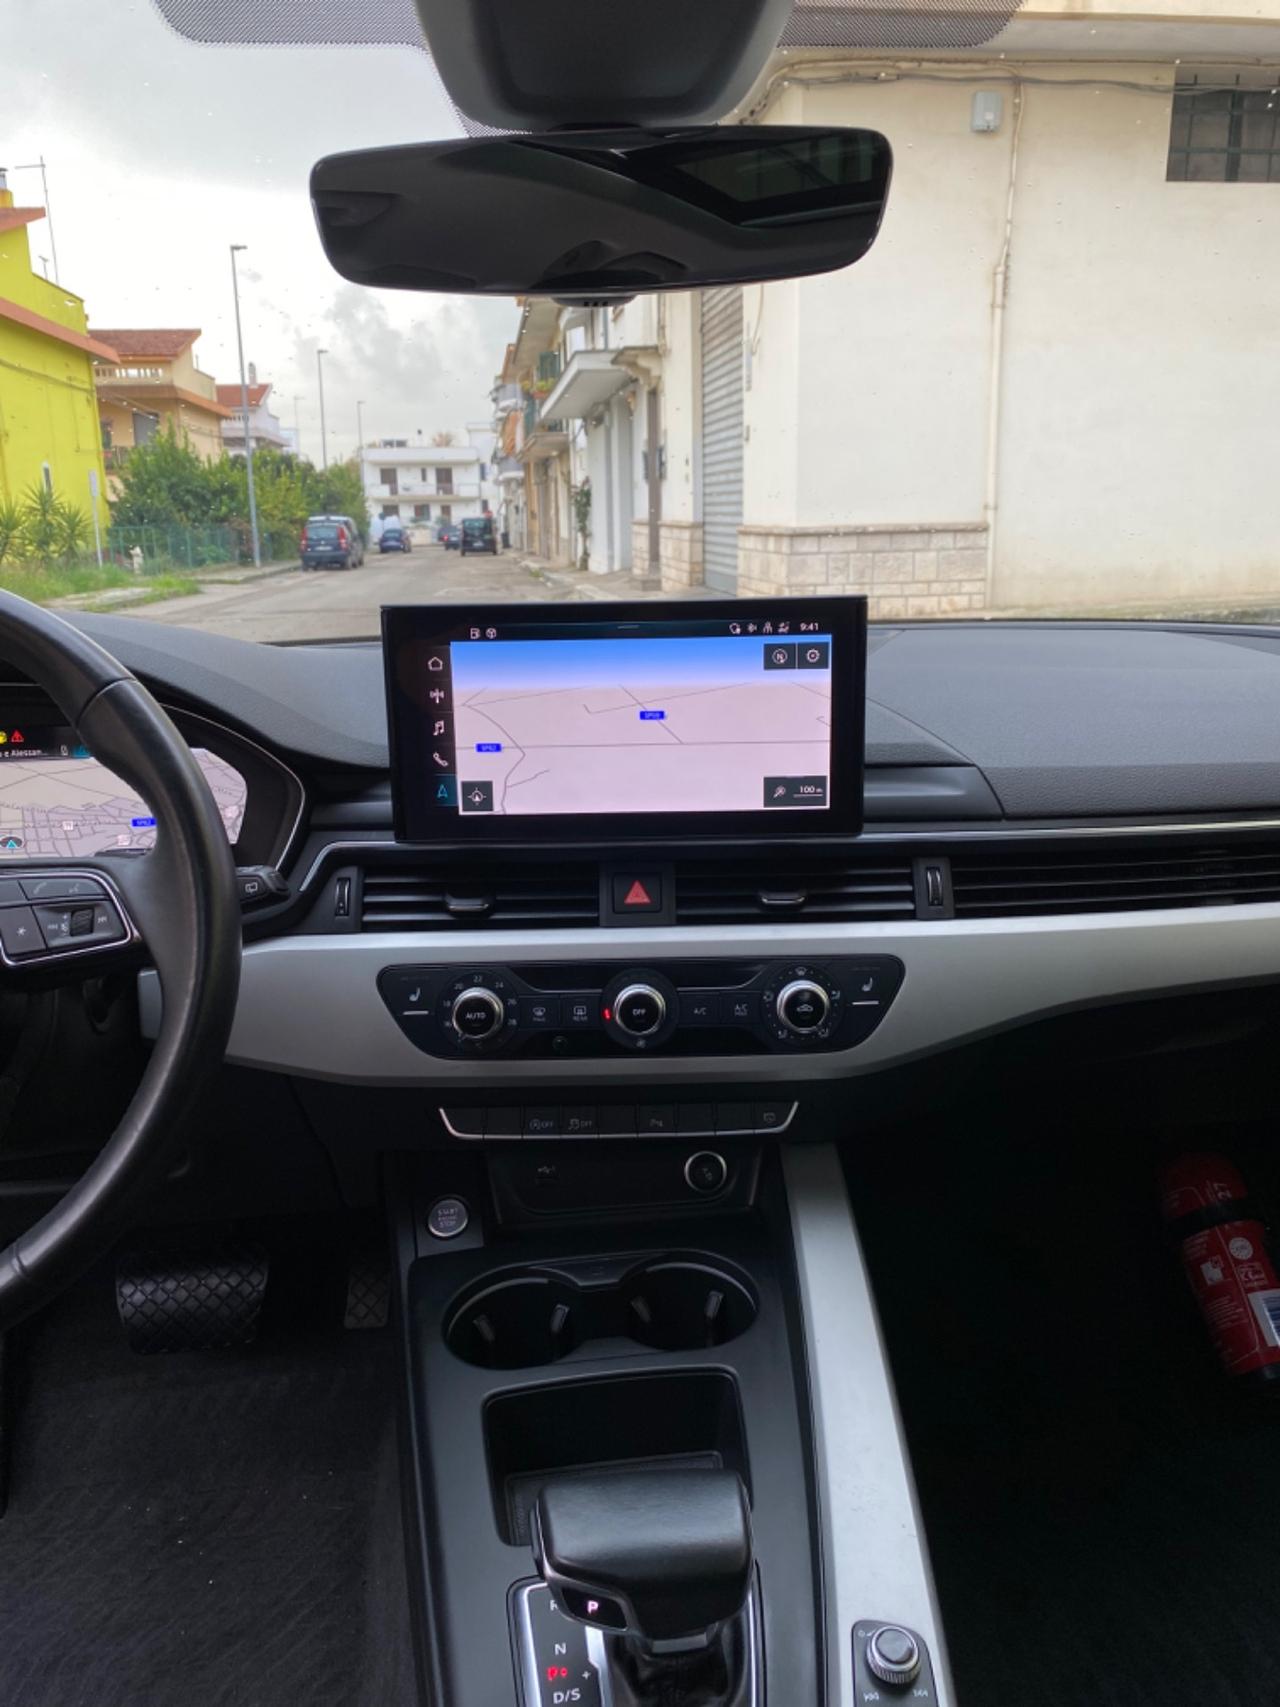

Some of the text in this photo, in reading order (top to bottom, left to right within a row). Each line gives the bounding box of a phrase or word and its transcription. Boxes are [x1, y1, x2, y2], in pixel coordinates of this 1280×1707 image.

[800, 622, 819, 631] 9:41
[800, 785, 815, 794] 100
[632, 1008, 646, 1016] OFF
[693, 1007, 707, 1015] A/C
[465, 1012, 486, 1020] AUTO
[586, 1600, 599, 1614] P
[554, 1643, 567, 1655] N
[553, 1688, 581, 1704] D/S
